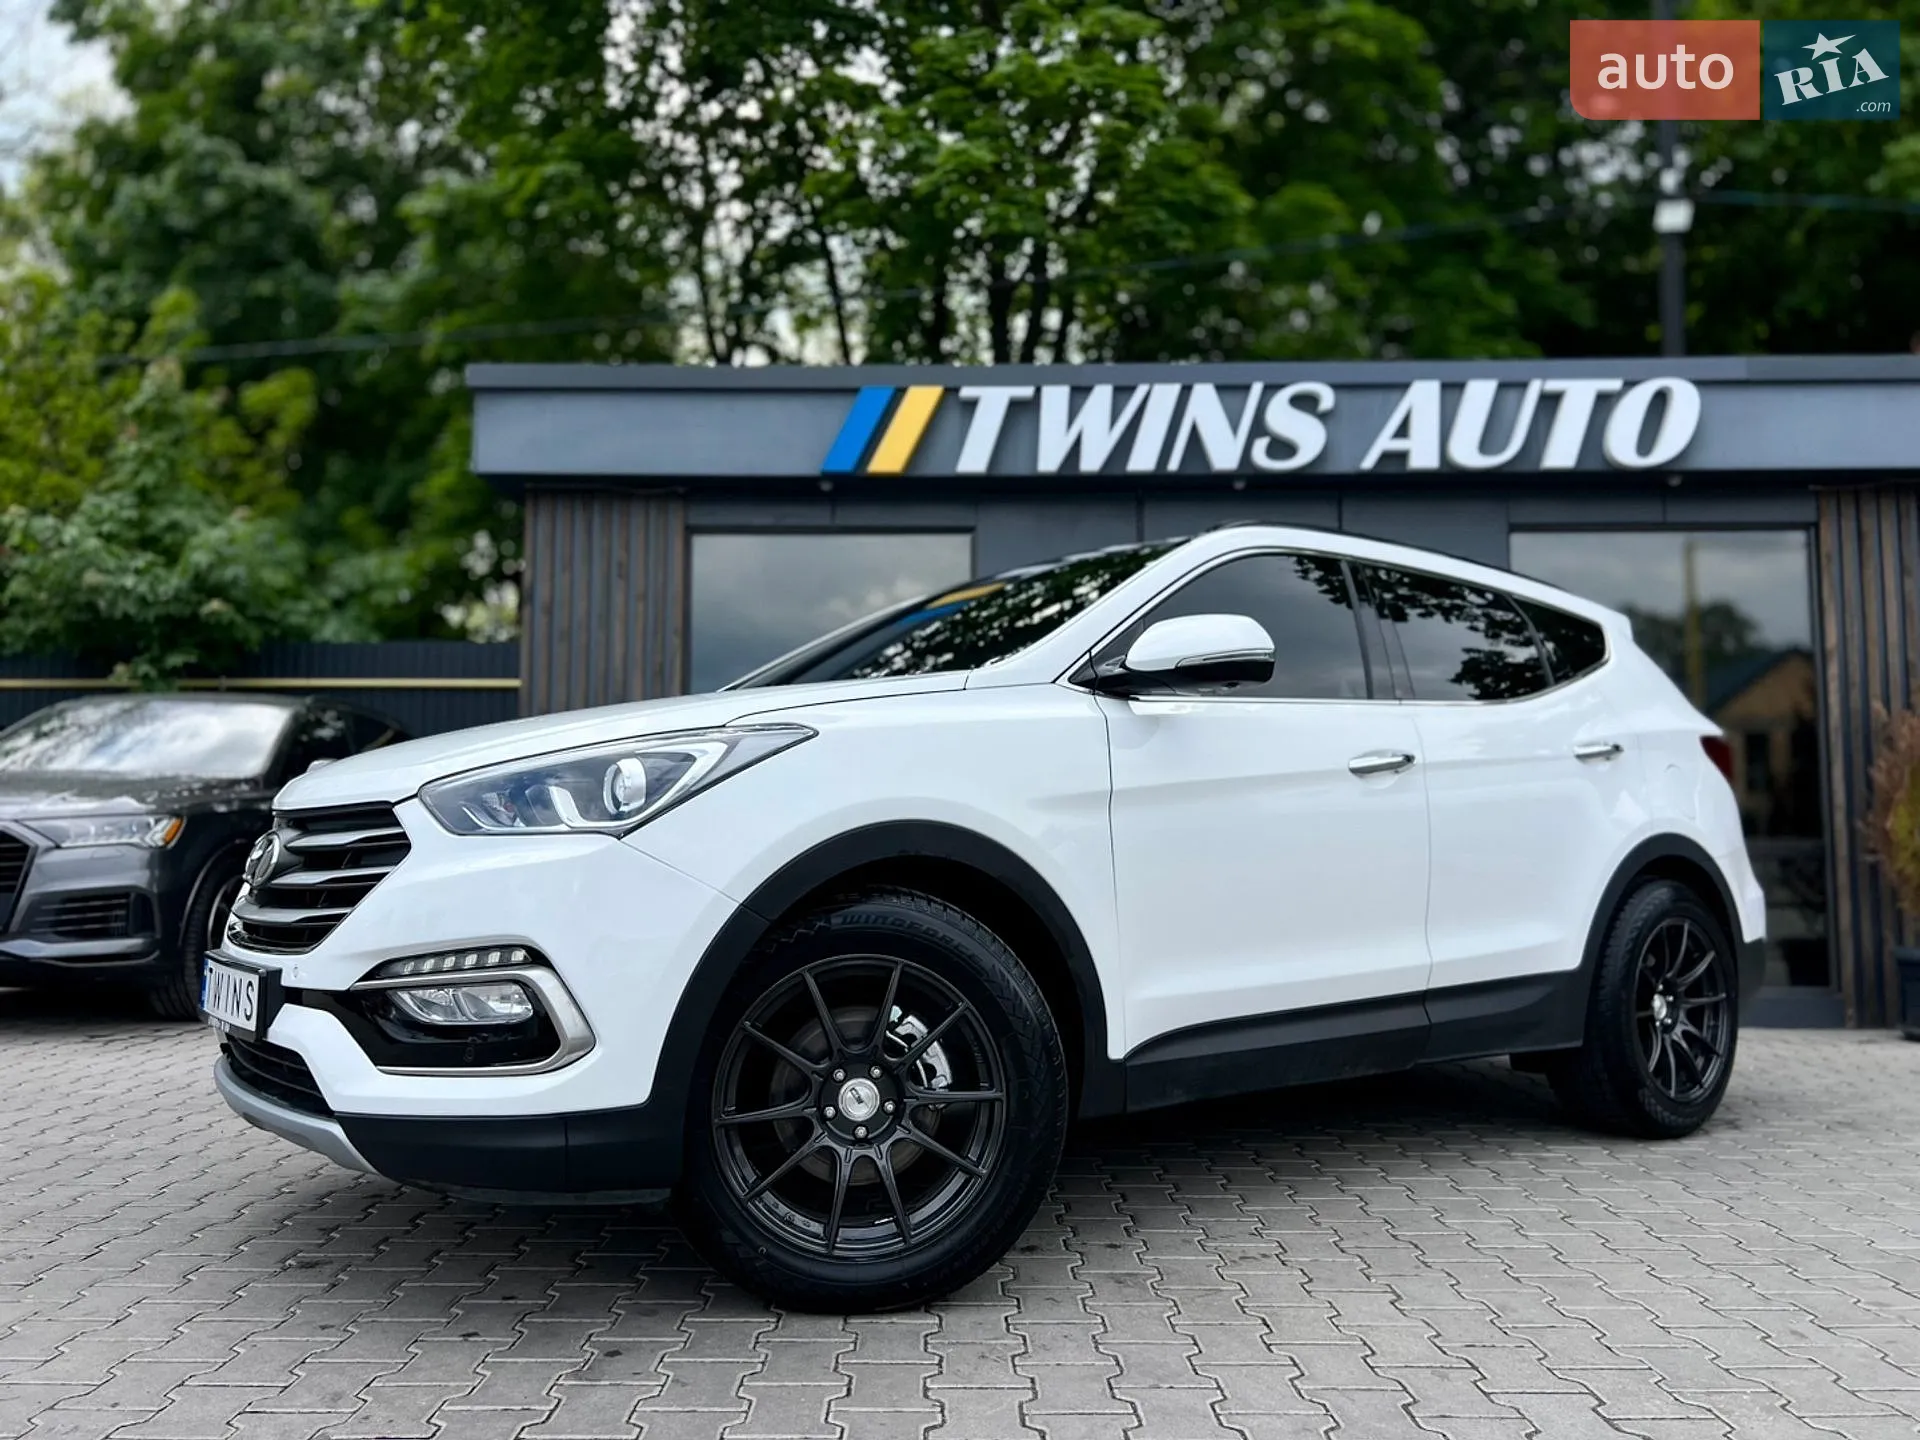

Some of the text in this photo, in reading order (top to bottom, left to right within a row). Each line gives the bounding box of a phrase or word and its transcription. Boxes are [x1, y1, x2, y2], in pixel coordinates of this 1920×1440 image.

[955, 376, 1702, 474] TWINS AUTO
[208, 967, 255, 1021] TWINS
